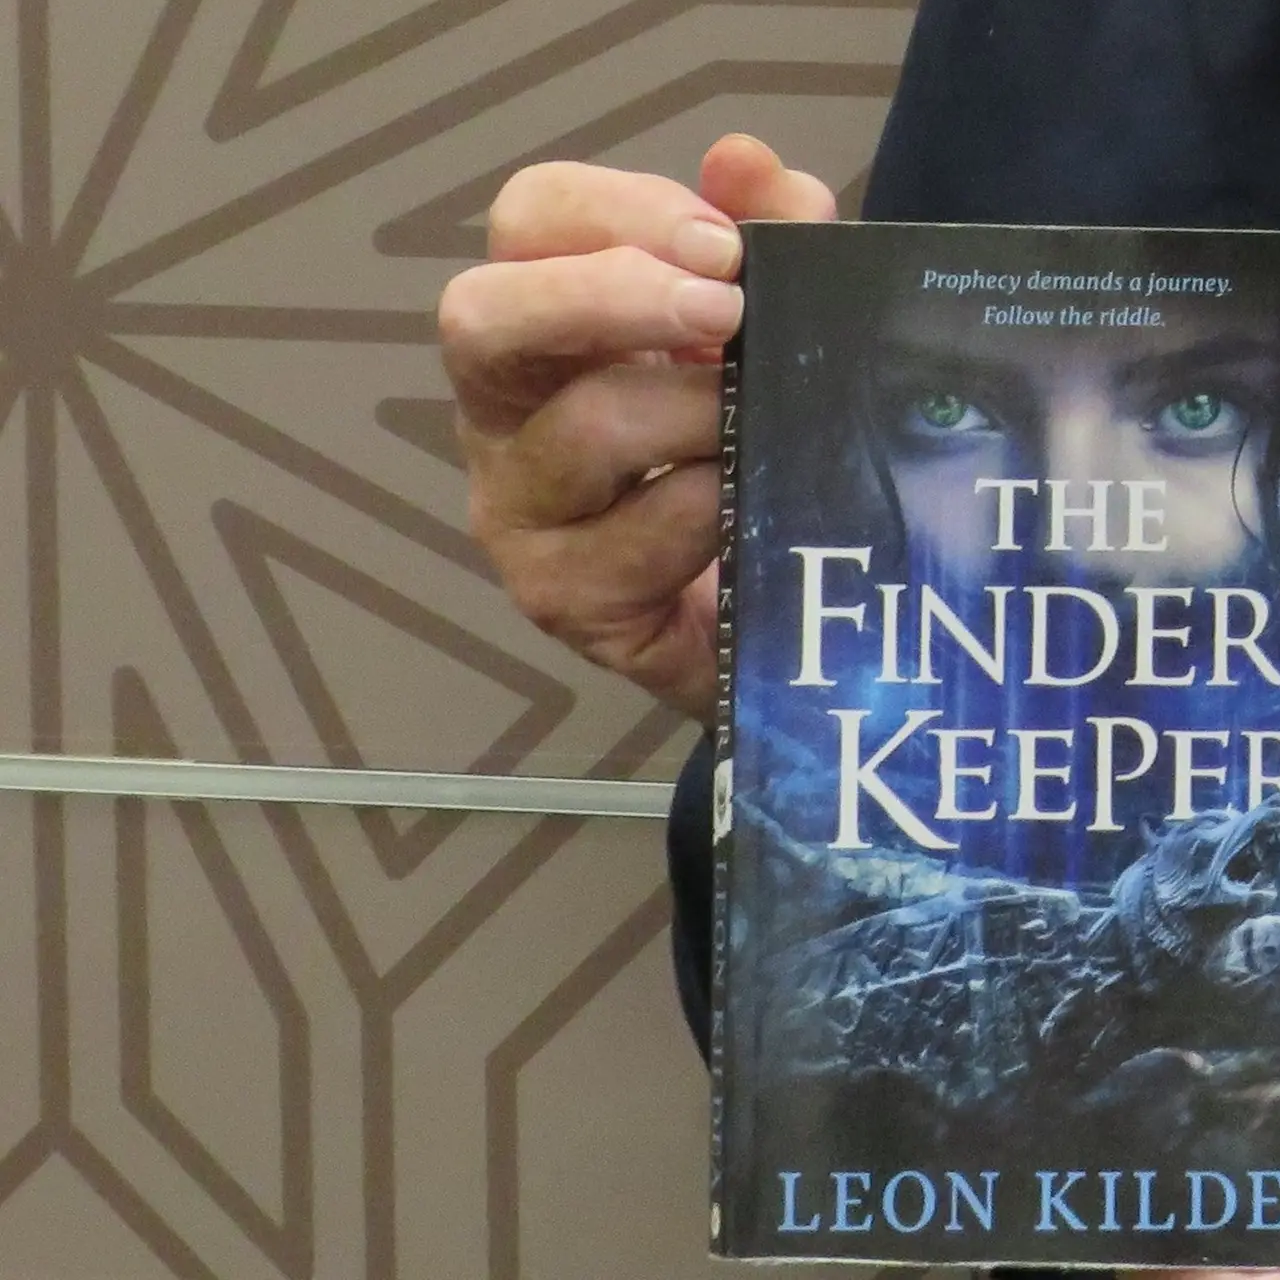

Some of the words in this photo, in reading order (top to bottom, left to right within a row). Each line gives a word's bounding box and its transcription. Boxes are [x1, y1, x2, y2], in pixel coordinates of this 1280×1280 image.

[921, 269, 1021, 296] Prophecy
[1026, 270, 1124, 292] demands
[1129, 276, 1142, 292] a
[1145, 272, 1234, 297] journey.
[981, 305, 1054, 327] Follow
[1059, 305, 1093, 326] the
[1099, 306, 1167, 328] riddle.
[974, 477, 1168, 553] THE
[777, 1170, 999, 1234] LEON
